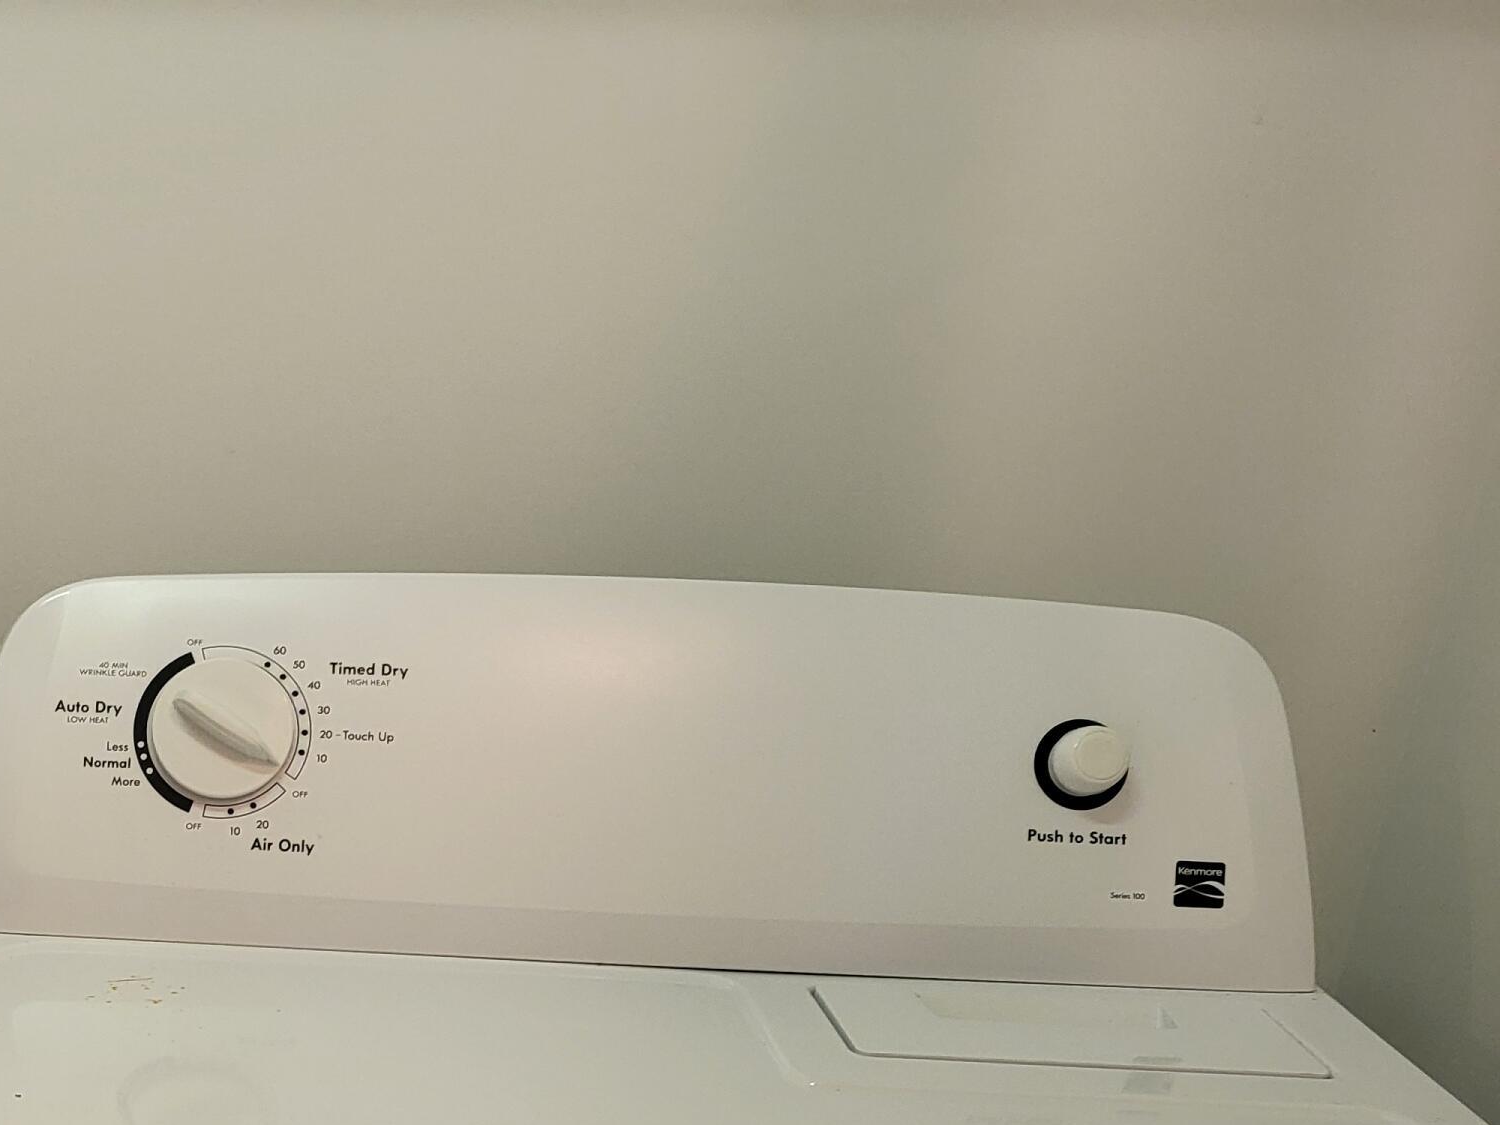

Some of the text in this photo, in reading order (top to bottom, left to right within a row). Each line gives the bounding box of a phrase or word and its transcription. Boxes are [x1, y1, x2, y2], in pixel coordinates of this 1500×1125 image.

[274, 646, 286, 655] 60
[293, 660, 305, 669] 50
[330, 662, 408, 681] Timed Dry
[308, 681, 320, 689] 40
[55, 700, 122, 718] Auto Dry
[317, 706, 330, 714] 30
[320, 730, 394, 744] 20 Touch Up
[107, 741, 128, 751] Less
[84, 757, 131, 768] Normal
[317, 754, 327, 763] 10
[111, 777, 140, 786] More
[256, 820, 269, 829] 20
[231, 827, 240, 836] 10
[1028, 829, 1126, 845] Push to Start
[251, 838, 314, 856] Air Only
[1178, 867, 1223, 876] Kenmore
